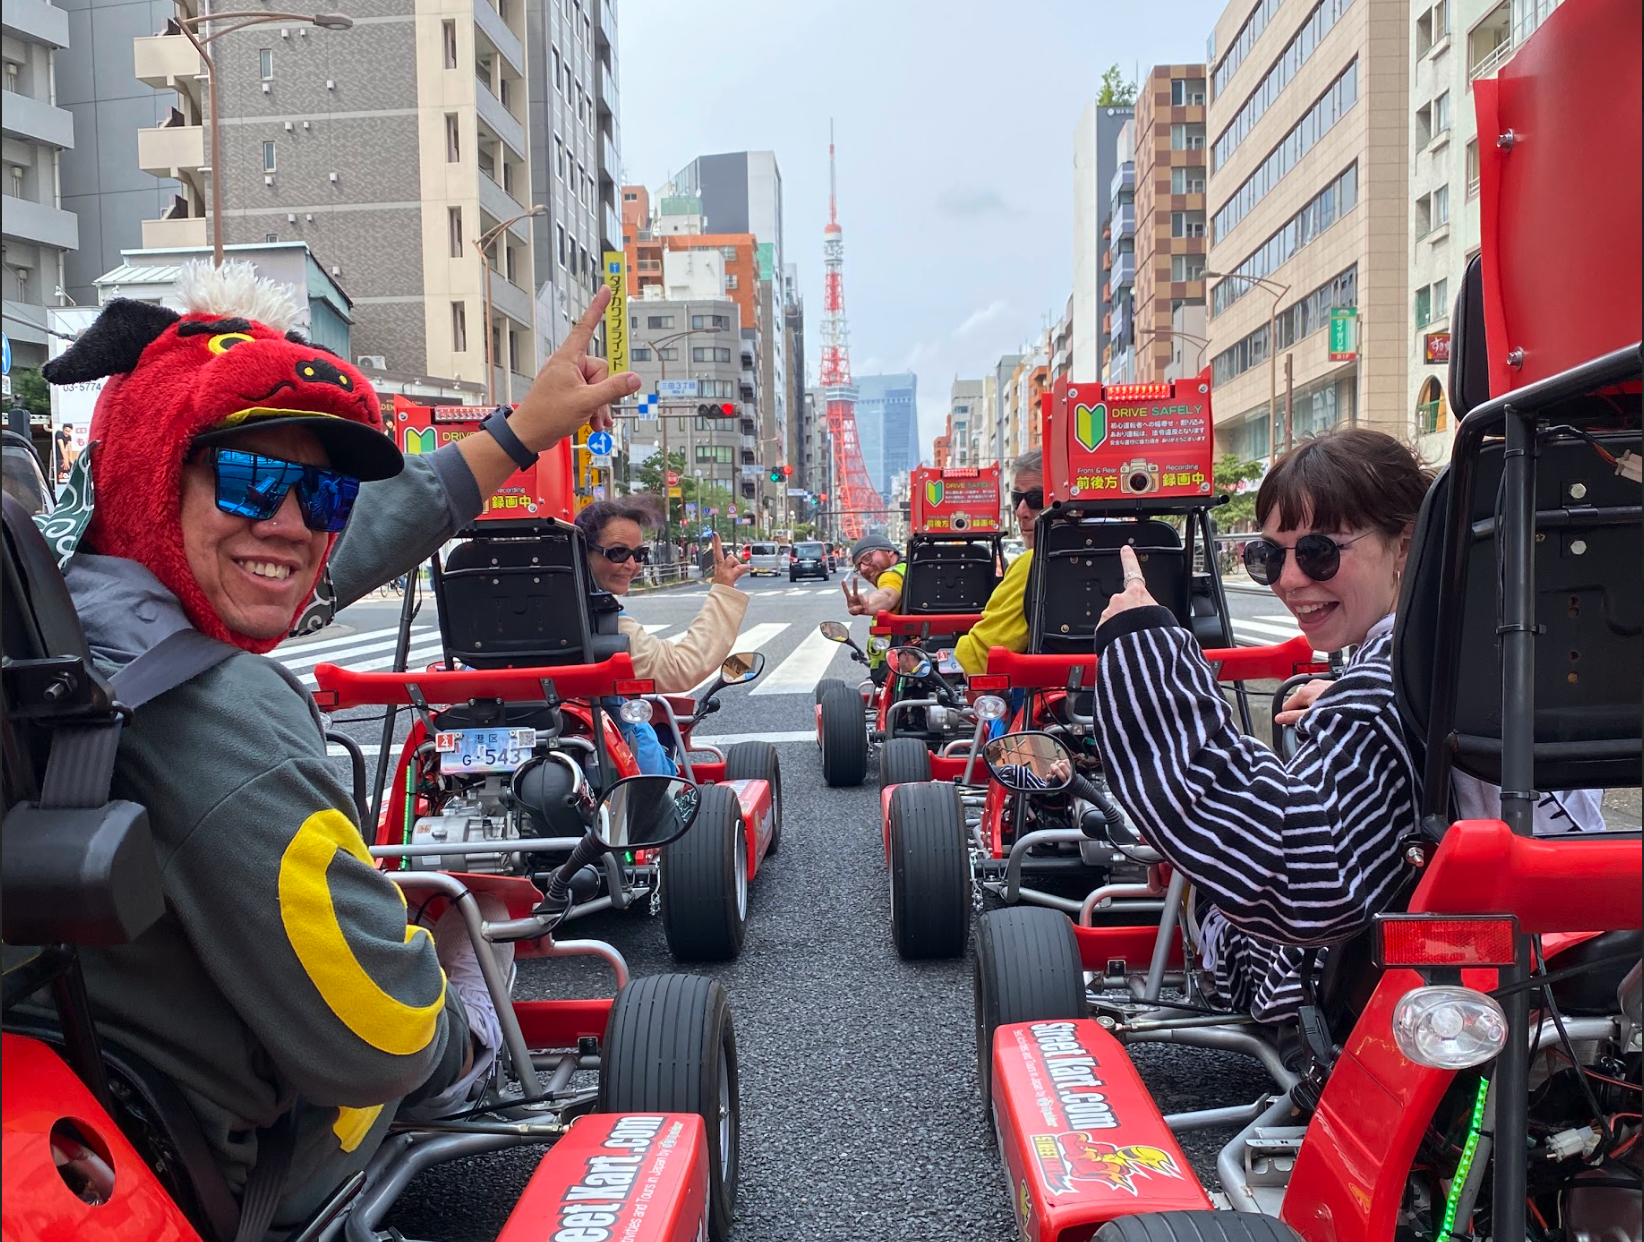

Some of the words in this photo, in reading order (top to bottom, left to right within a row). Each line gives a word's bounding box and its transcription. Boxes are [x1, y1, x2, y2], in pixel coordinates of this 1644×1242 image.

[610, 275, 623, 371] タチカワブラインド
[1112, 408, 1148, 418] DRIVE
[1151, 404, 1203, 416] SAFELY
[1076, 475, 1118, 490] 前後方
[1162, 472, 1205, 487] 録画中
[492, 495, 532, 509] 録画中
[656, 1148, 672, 1157] by
[648, 1157, 667, 1176] Japan
[635, 1183, 656, 1203] Tours
[632, 1203, 648, 1218] and
